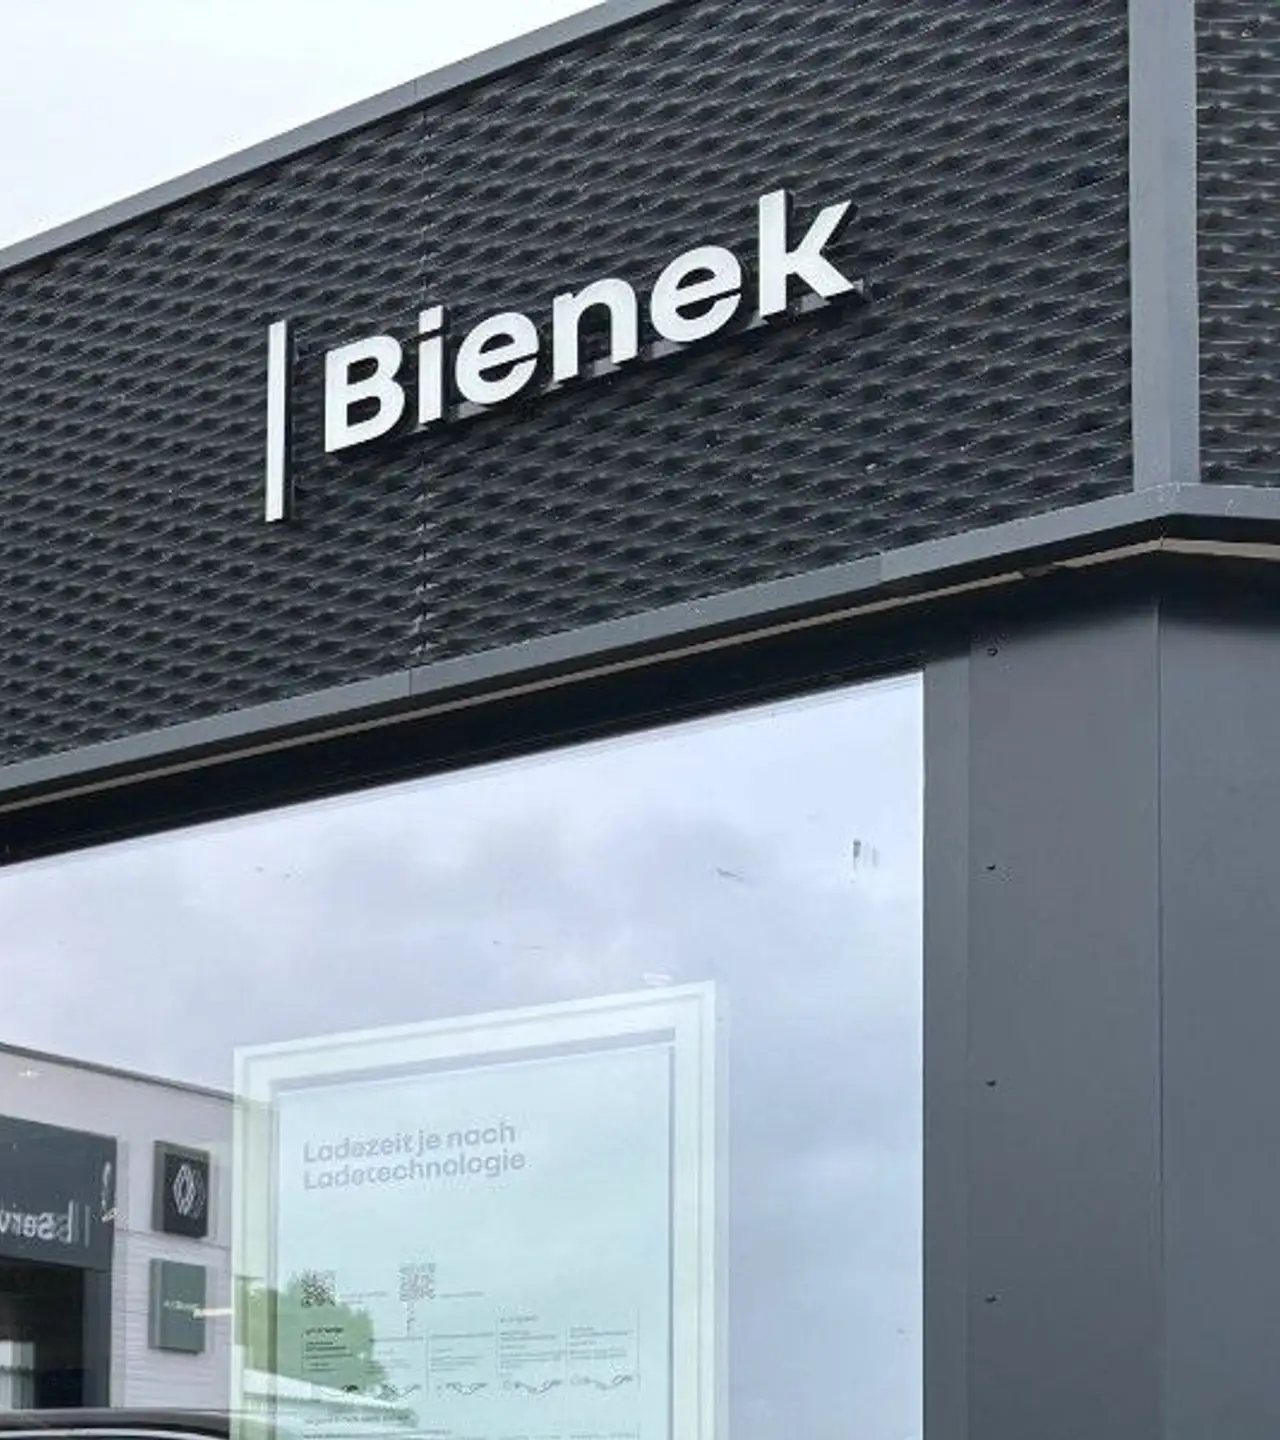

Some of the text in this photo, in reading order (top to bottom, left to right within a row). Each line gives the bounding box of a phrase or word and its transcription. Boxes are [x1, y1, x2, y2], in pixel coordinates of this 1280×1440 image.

[325, 188, 855, 453] Bienek
[303, 1121, 516, 1164] Ladezeit je nach
[303, 1148, 526, 1190] Ladetechnologie
